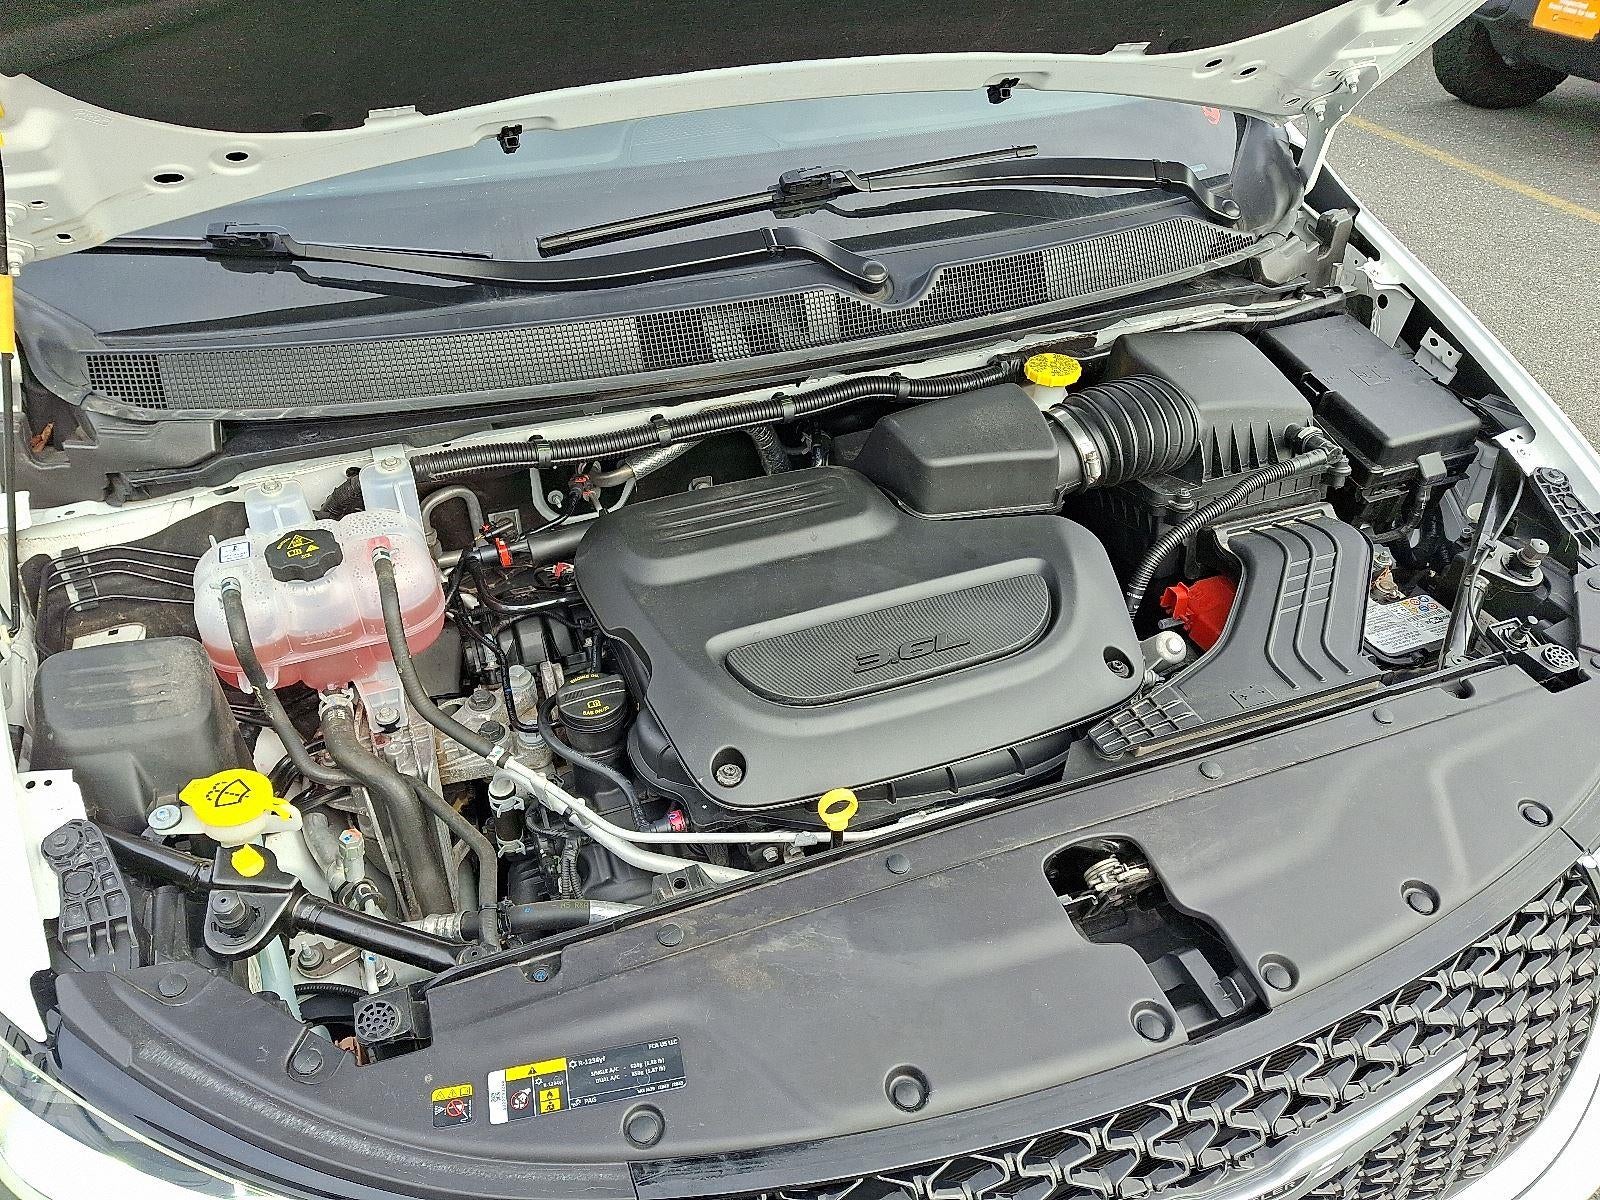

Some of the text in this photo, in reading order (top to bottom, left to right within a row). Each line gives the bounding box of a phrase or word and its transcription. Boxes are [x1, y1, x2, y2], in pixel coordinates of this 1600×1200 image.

[854, 633, 971, 674] 3.6L
[648, 1042, 660, 1050] FCA
[578, 1056, 606, 1066] R-1234yf
[590, 1069, 609, 1077] SINGLE
[595, 1076, 609, 1084] DUAL
